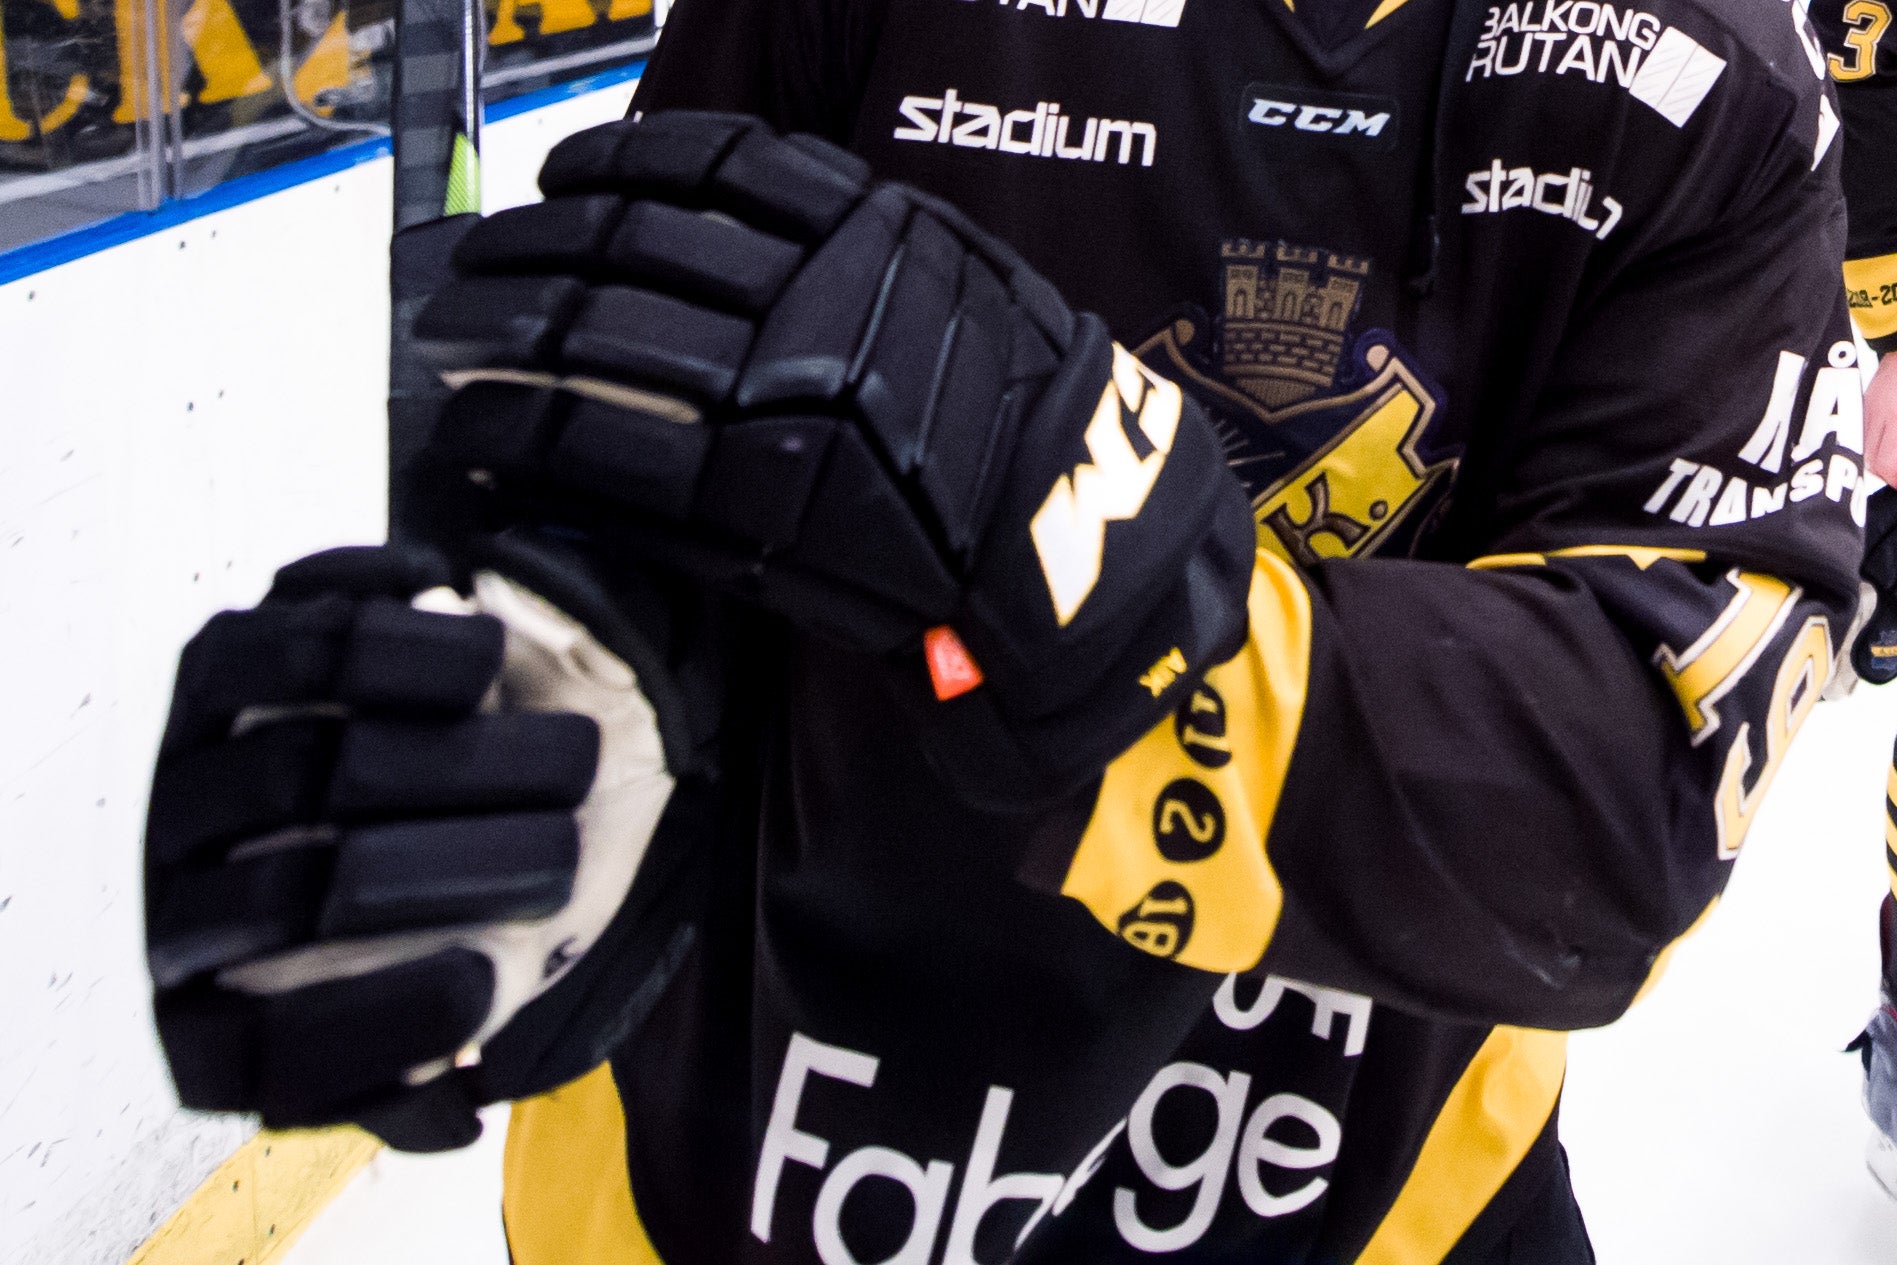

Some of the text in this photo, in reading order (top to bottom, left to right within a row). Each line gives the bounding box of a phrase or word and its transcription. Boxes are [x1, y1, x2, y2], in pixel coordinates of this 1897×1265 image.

[894, 88, 1157, 167] stadium
[1248, 98, 1392, 138] CCM
[750, 1030, 1343, 1265] Fabge
